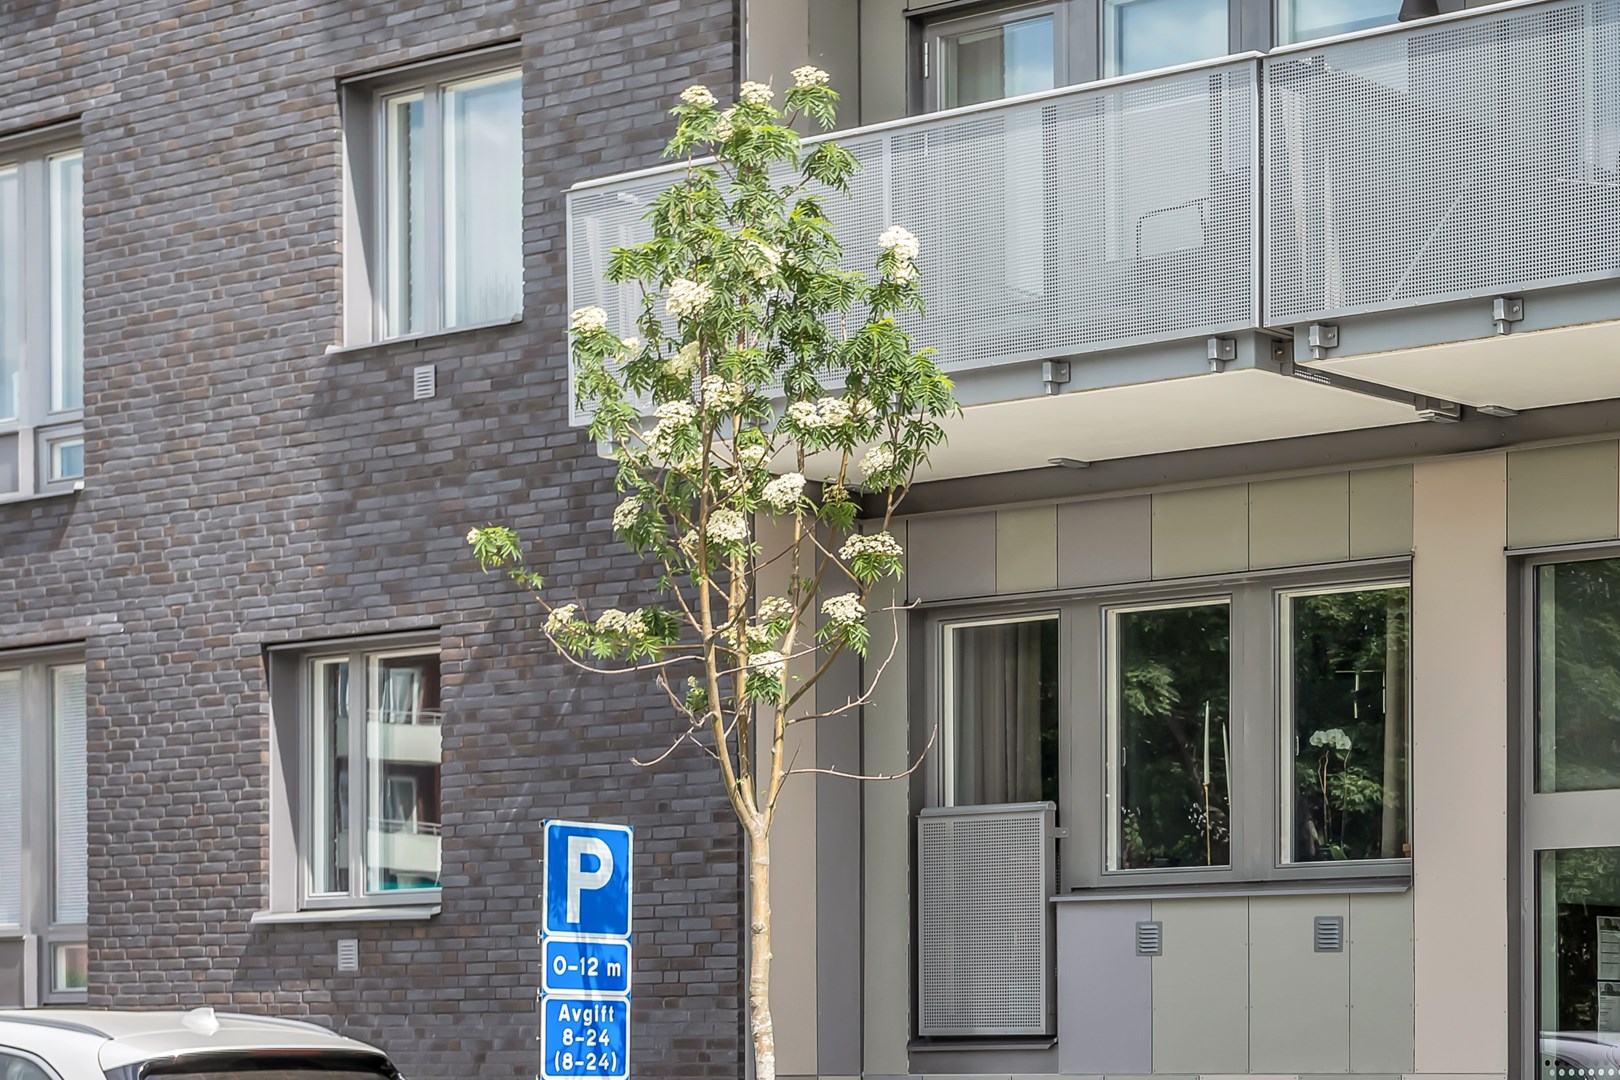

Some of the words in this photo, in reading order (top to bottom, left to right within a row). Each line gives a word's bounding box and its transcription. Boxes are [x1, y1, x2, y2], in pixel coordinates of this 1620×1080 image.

[566, 835, 614, 924] P
[553, 955, 599, 977] 0-12
[607, 962, 621, 977] m
[558, 1003, 614, 1027] Avgift
[562, 1028, 610, 1047] 8-24
[554, 1050, 617, 1072] (8-24)
